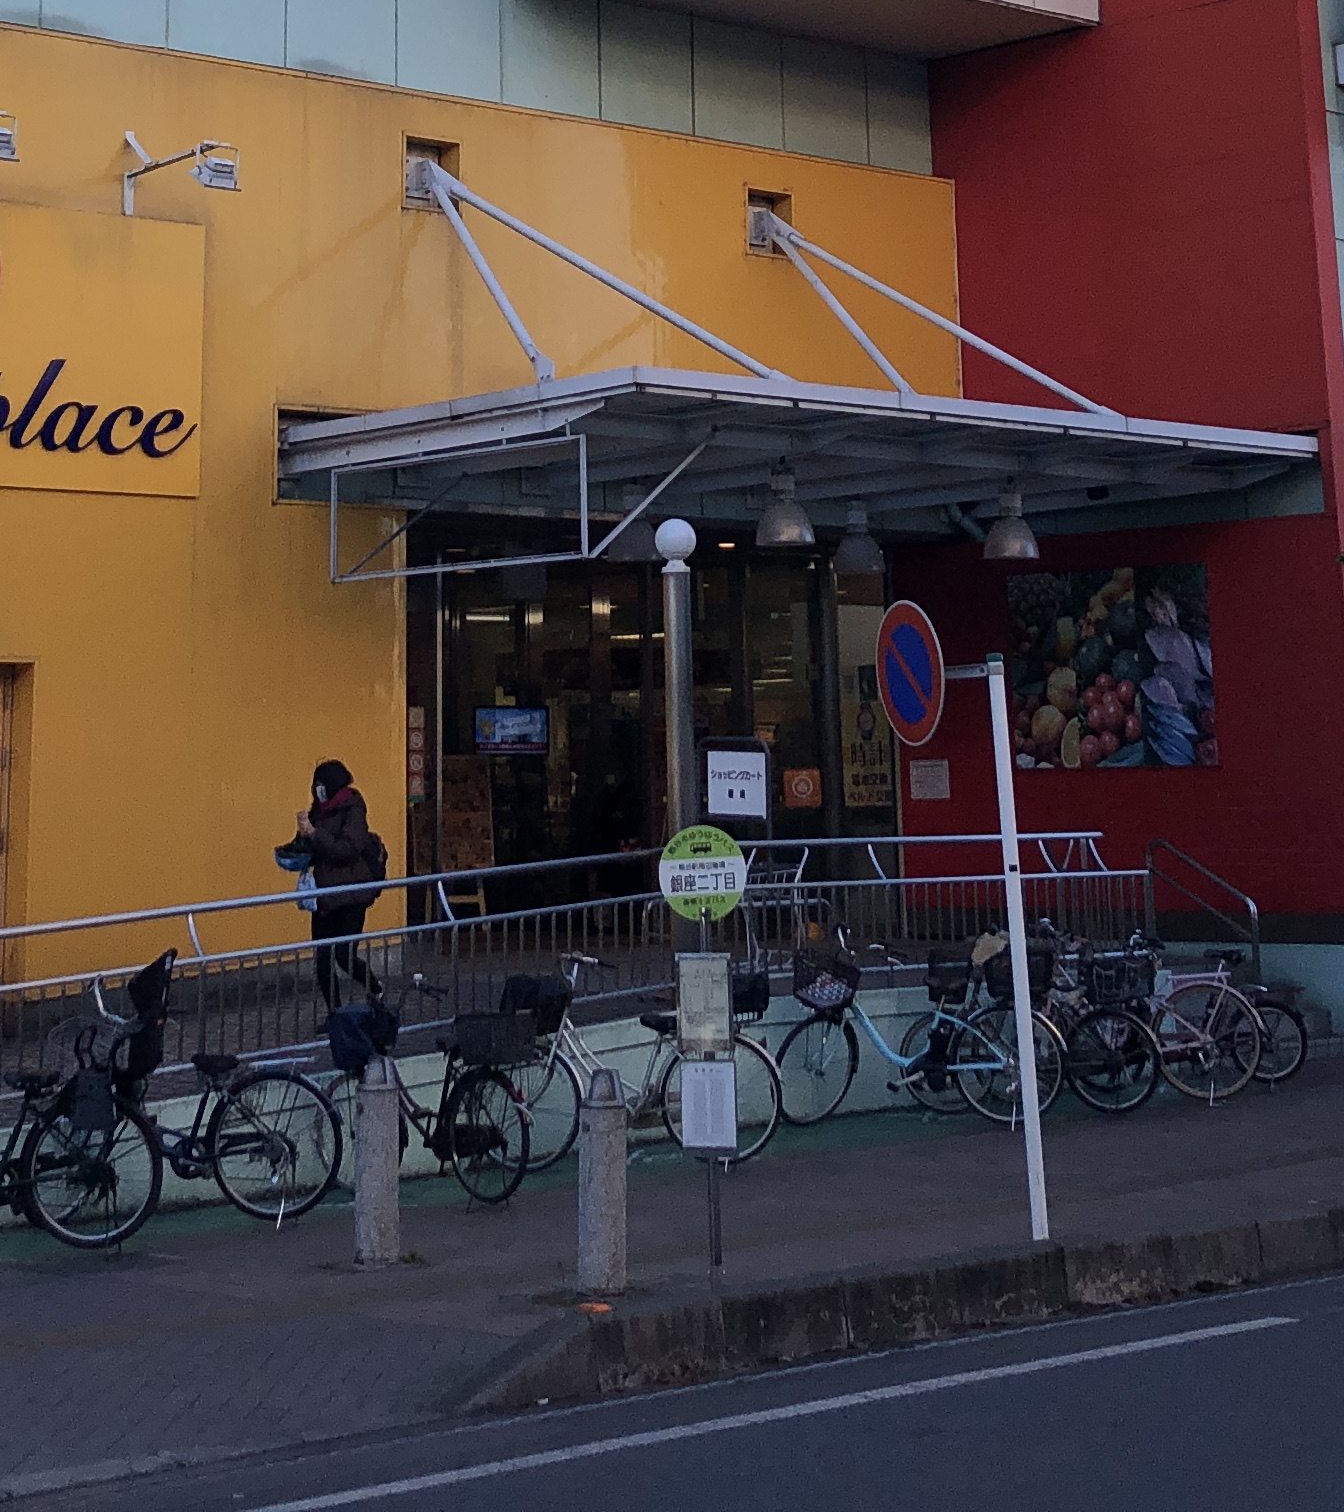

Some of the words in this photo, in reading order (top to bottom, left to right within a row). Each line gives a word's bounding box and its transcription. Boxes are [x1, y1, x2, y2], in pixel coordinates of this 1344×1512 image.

[710, 769, 763, 781] ショッピングカート
[670, 872, 736, 893] 銀座二丁目
